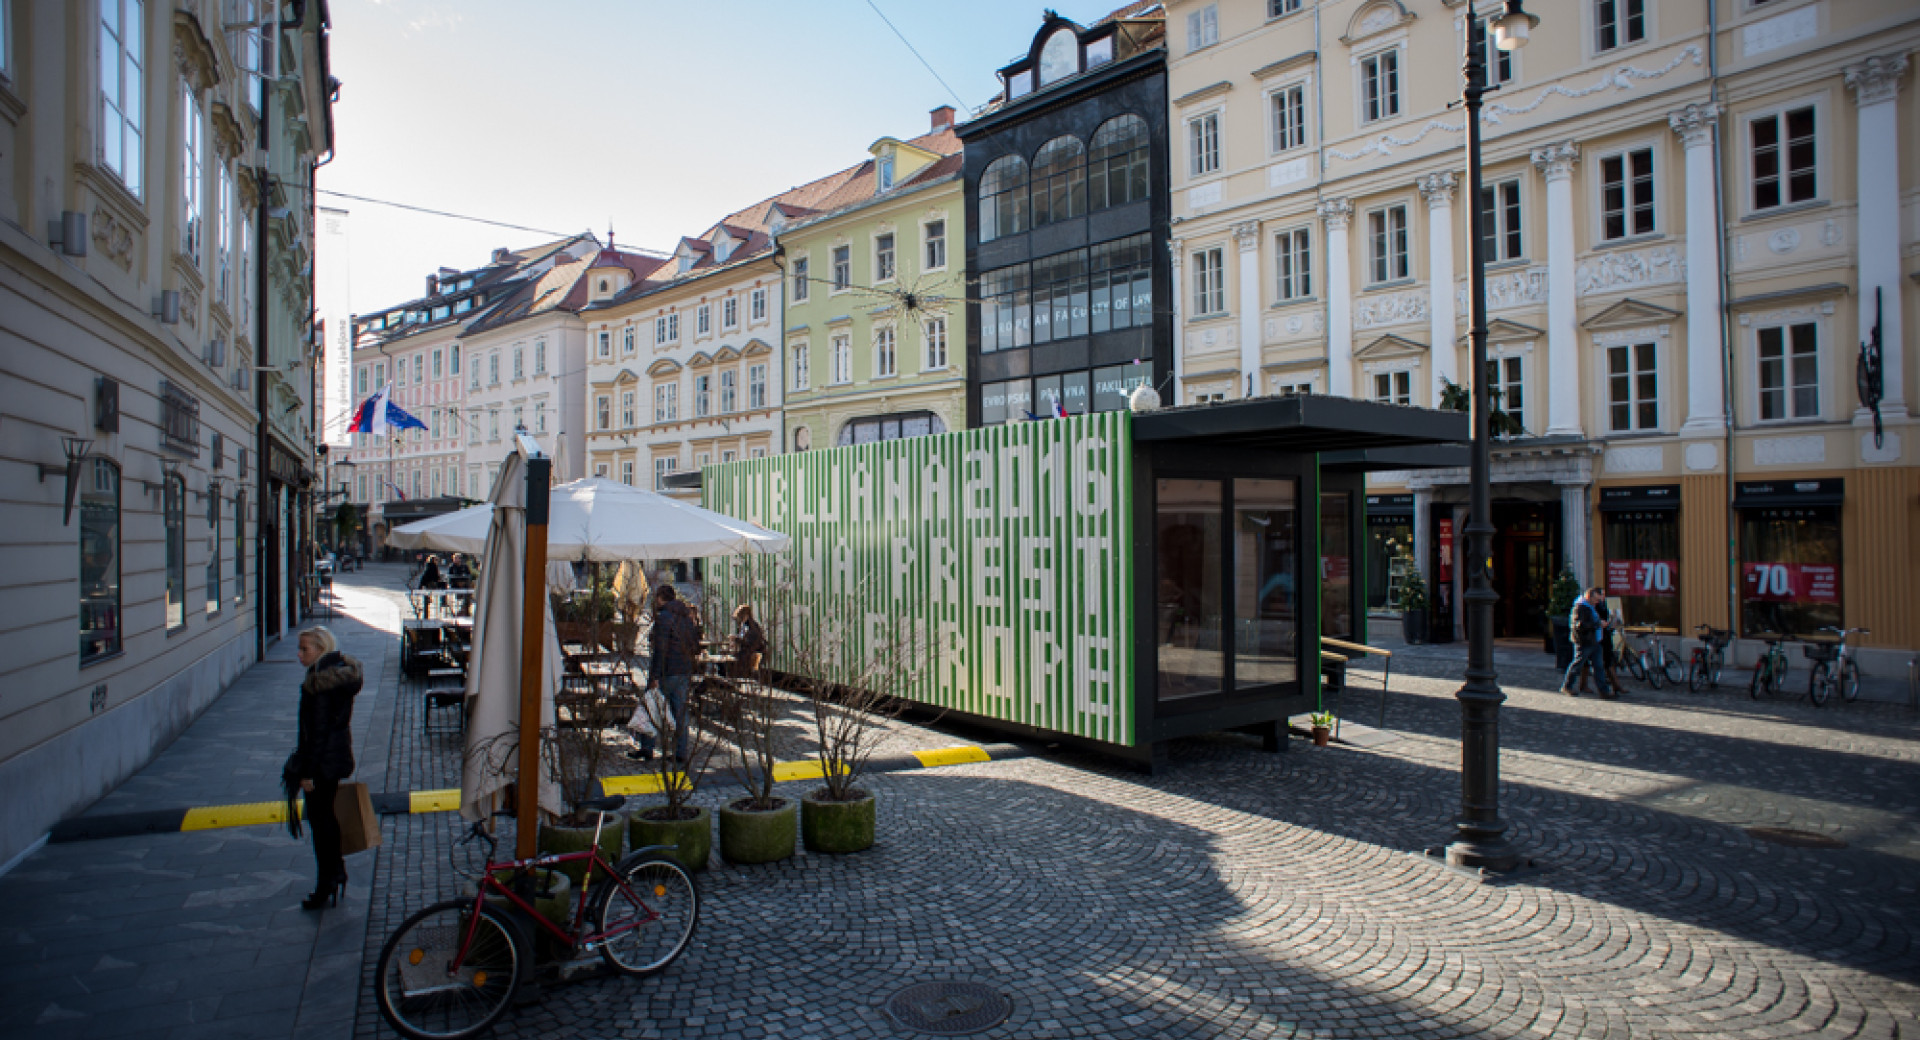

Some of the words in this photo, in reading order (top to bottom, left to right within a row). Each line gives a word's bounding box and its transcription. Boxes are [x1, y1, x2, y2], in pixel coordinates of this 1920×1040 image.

[982, 312, 1049, 337] EUROPEAN
[1055, 301, 1110, 322] FACULTY
[1115, 297, 1128, 310] OF
[966, 437, 1108, 518] 2016
